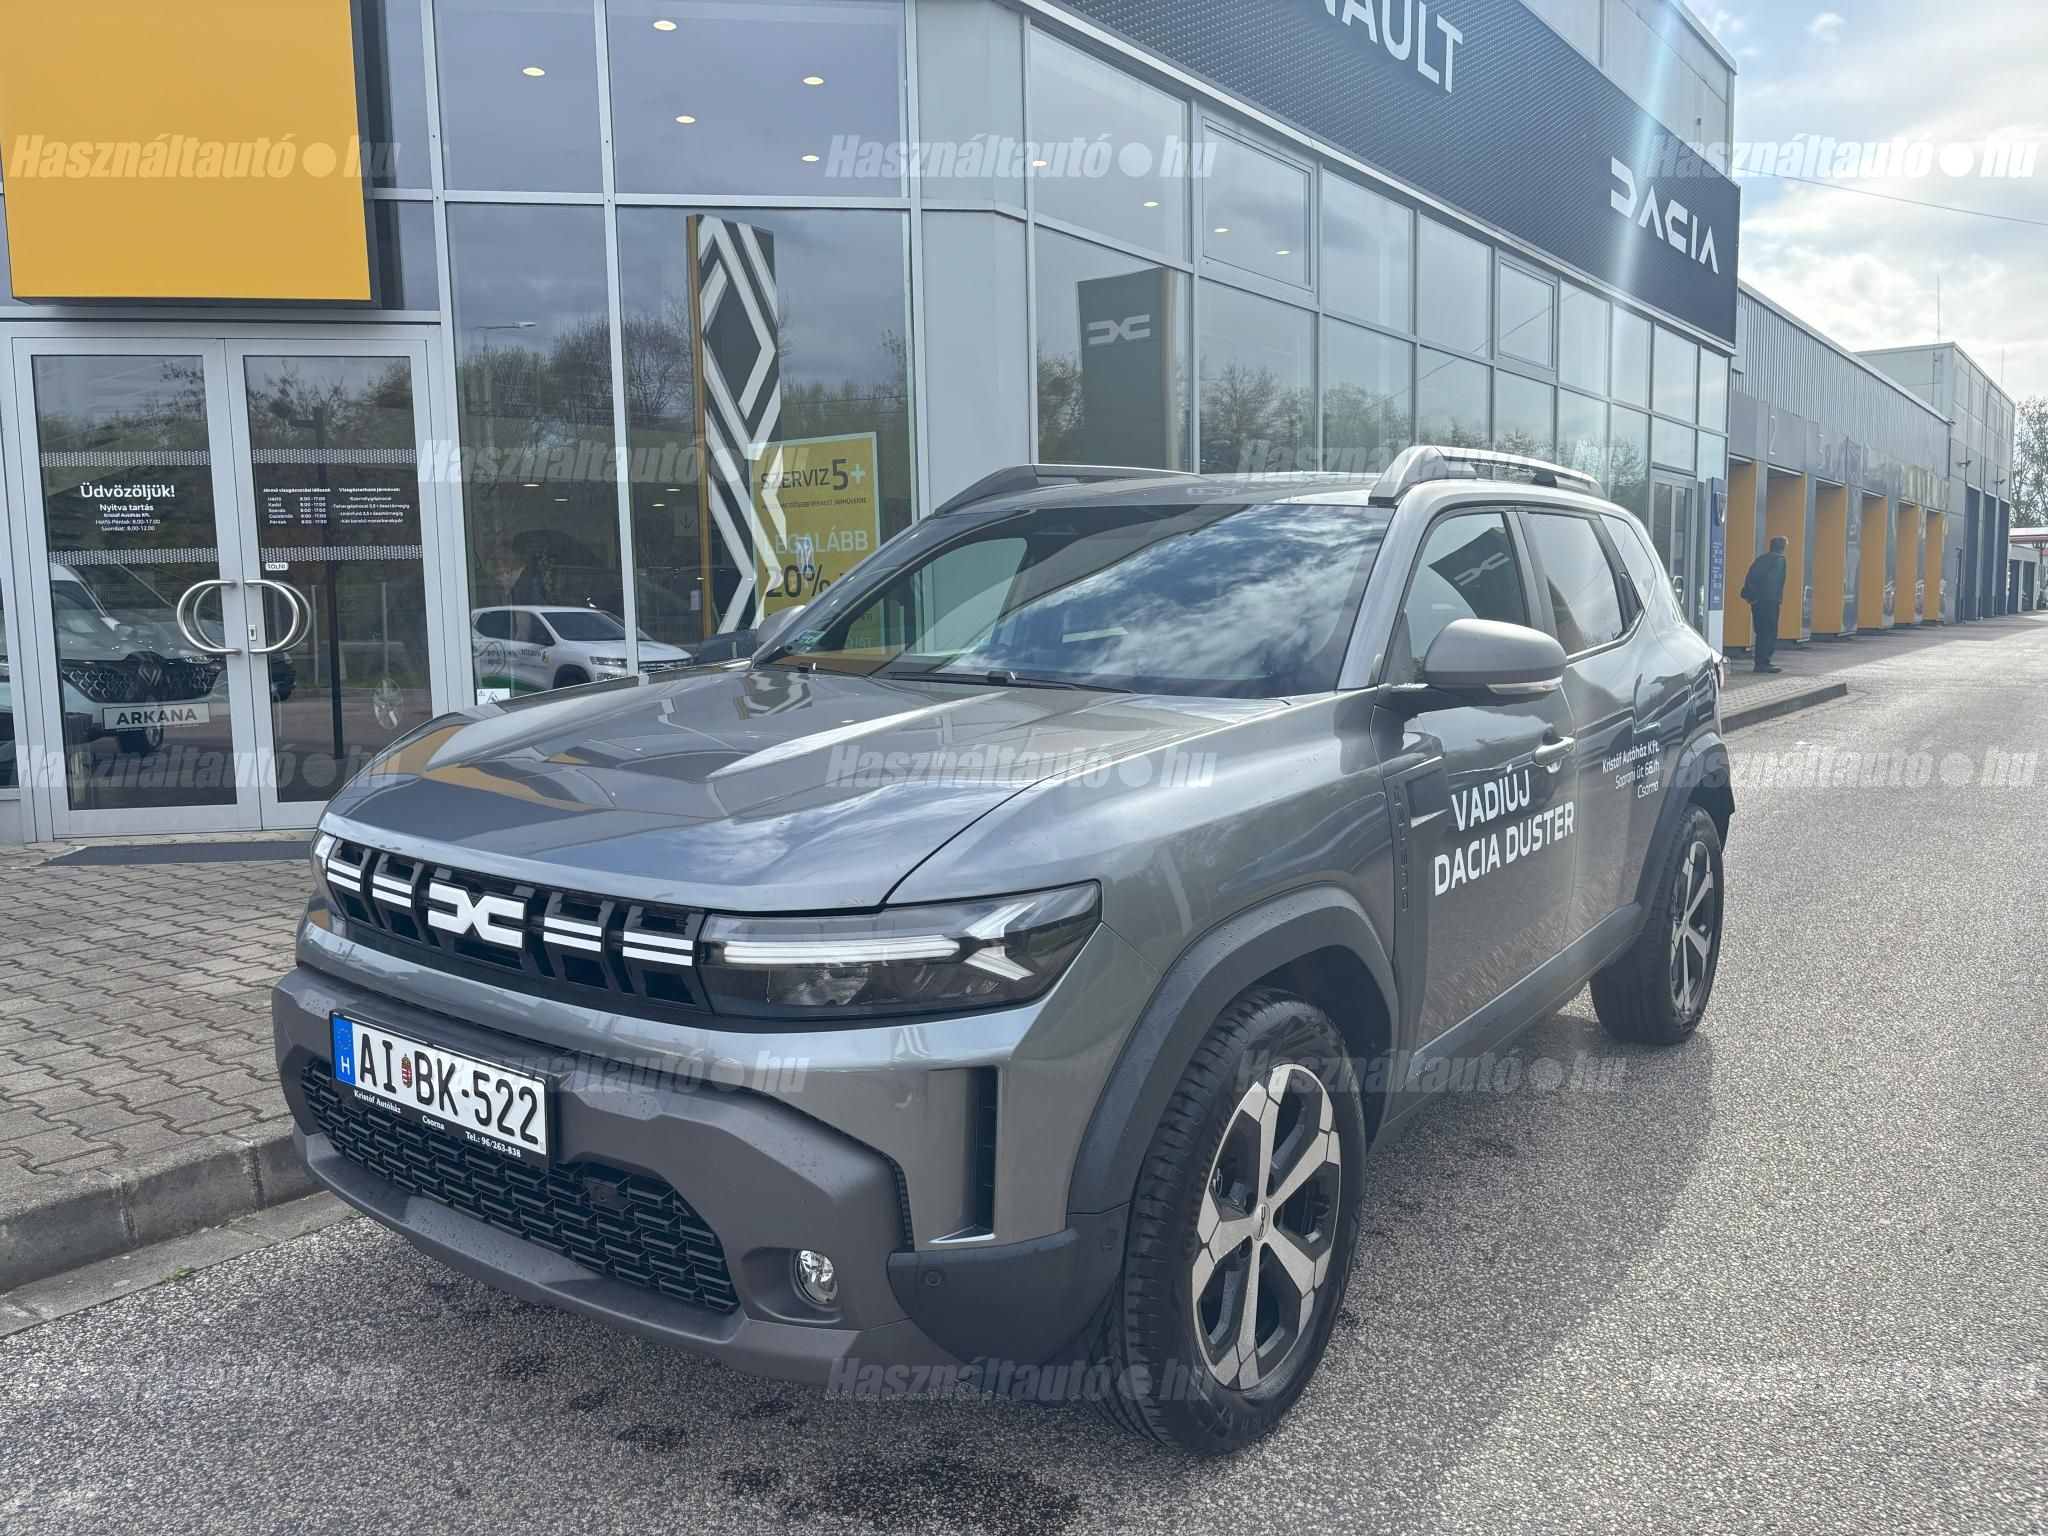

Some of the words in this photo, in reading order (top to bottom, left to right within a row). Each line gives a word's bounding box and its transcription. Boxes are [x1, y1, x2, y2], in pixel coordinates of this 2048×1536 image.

[1325, 0, 1463, 93] AULT
[1610, 156, 1719, 274] DACIA
[760, 467, 830, 489] SZERVIZ
[80, 482, 175, 500] Üdvözöljük!
[100, 503, 128, 513] Nyitva
[129, 503, 154, 511] tartás
[116, 707, 198, 726] ARKANA
[1602, 752, 1622, 774] Kristóf
[1636, 764, 1644, 780] út
[1451, 764, 1531, 832] VADIÚJ
[1637, 780, 1659, 798] Csorna
[1434, 832, 1502, 896] DACIA
[1505, 801, 1575, 865] DUSTER
[340, 1055, 351, 1076] H
[359, 1033, 397, 1094] AI
[414, 1050, 539, 1145] BK-522
[353, 1089, 375, 1104] Kristóf
[375, 1095, 402, 1114] Autóház
[422, 1115, 445, 1131] Csorna
[465, 1130, 481, 1144] Tel.:
[481, 1135, 522, 1158] 96/263-838
